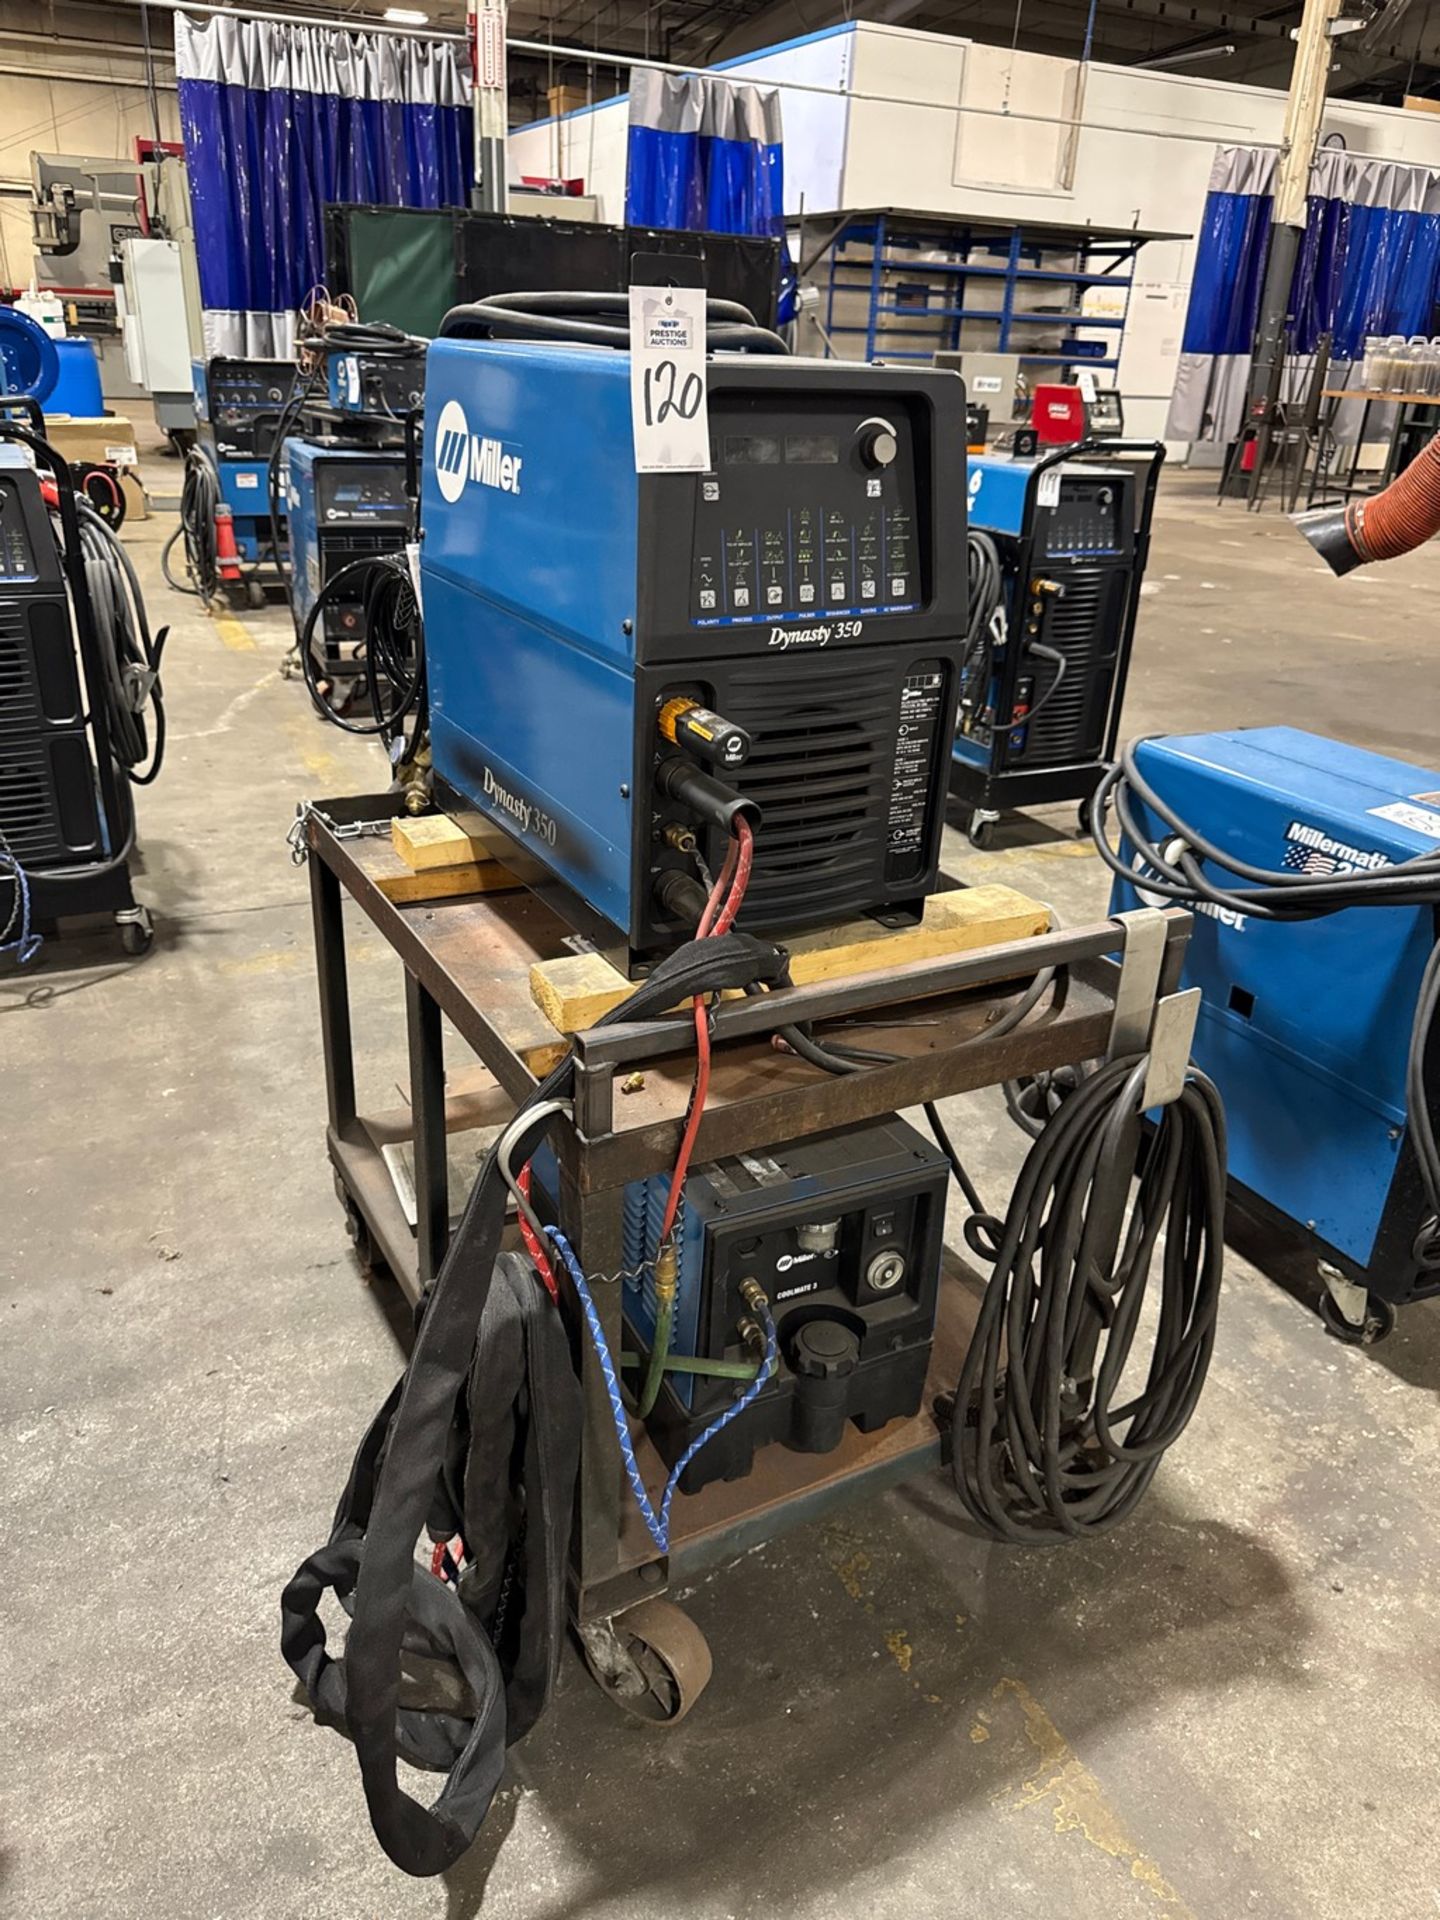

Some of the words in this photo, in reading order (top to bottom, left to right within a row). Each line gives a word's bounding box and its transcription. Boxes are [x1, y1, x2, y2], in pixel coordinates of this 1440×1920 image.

[650, 329, 687, 338] PRESTIGE
[650, 338, 687, 346] AUCTIONS
[644, 360, 703, 427] 120
[470, 434, 522, 495] Miller
[768, 625, 832, 651] Dynasty
[834, 620, 863, 640] 350
[483, 765, 532, 833] Dynasty
[532, 807, 557, 848] 350
[776, 1283, 812, 1300] COOLMATE
[813, 1282, 818, 1290] 3
